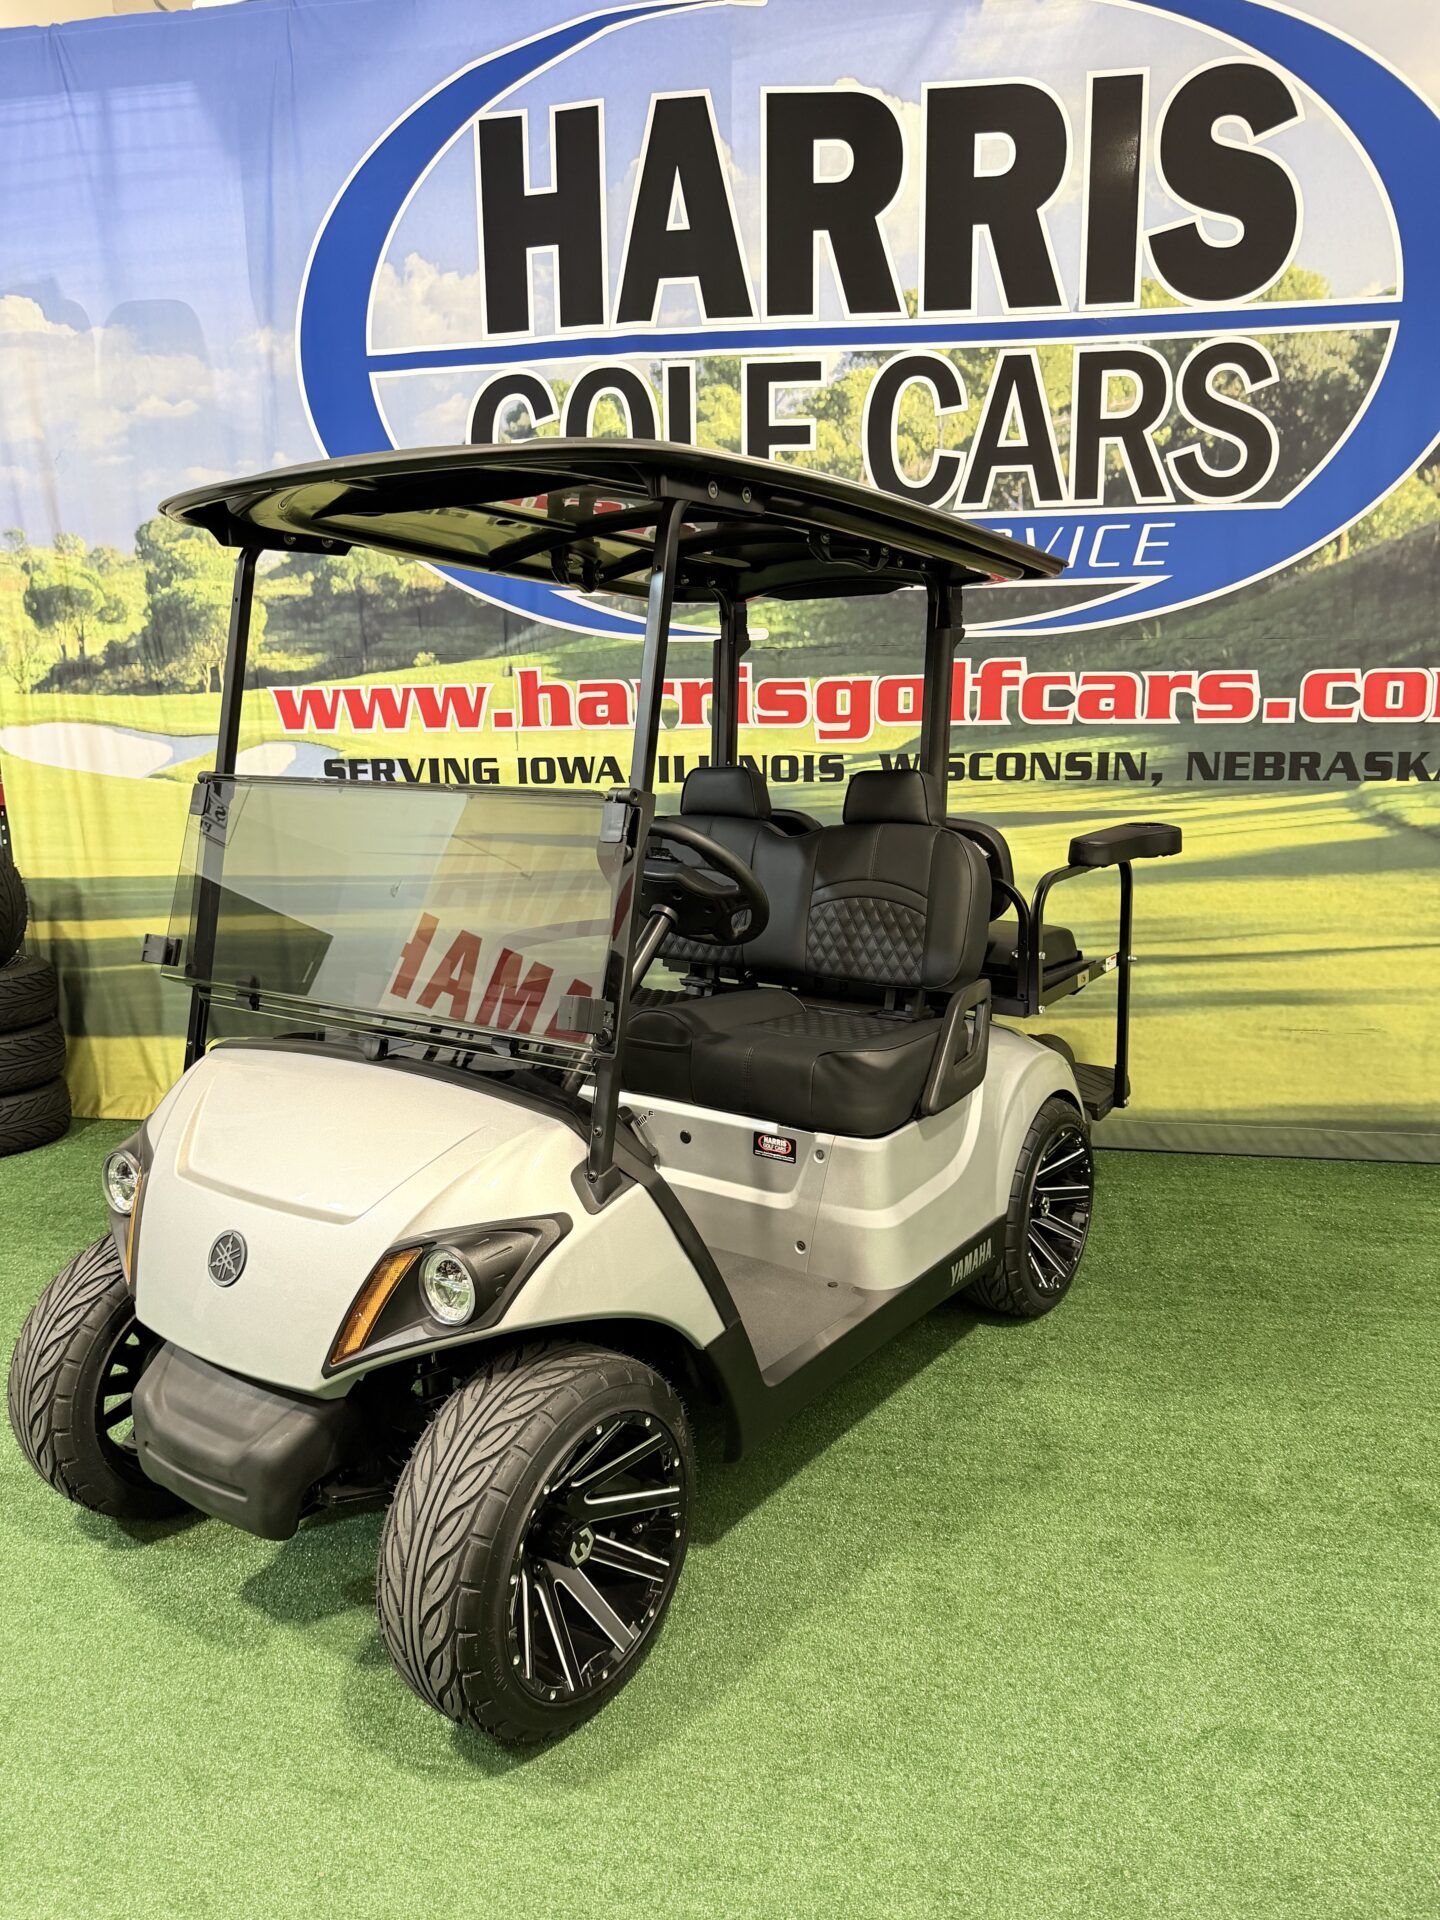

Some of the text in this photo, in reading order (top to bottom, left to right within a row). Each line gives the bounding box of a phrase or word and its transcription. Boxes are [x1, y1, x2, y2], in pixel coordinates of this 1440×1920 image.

[477, 60, 1306, 337] HARRIS
[863, 340, 1284, 505] CARS
[267, 657, 1440, 743] www.harisgolfcars.co
[324, 757, 500, 785] SERVING
[517, 755, 632, 784] IOWA
[879, 751, 1164, 787] WSCONSIN,
[1186, 751, 1440, 783] NEBRASK
[951, 1238, 992, 1287] YAMAHA
